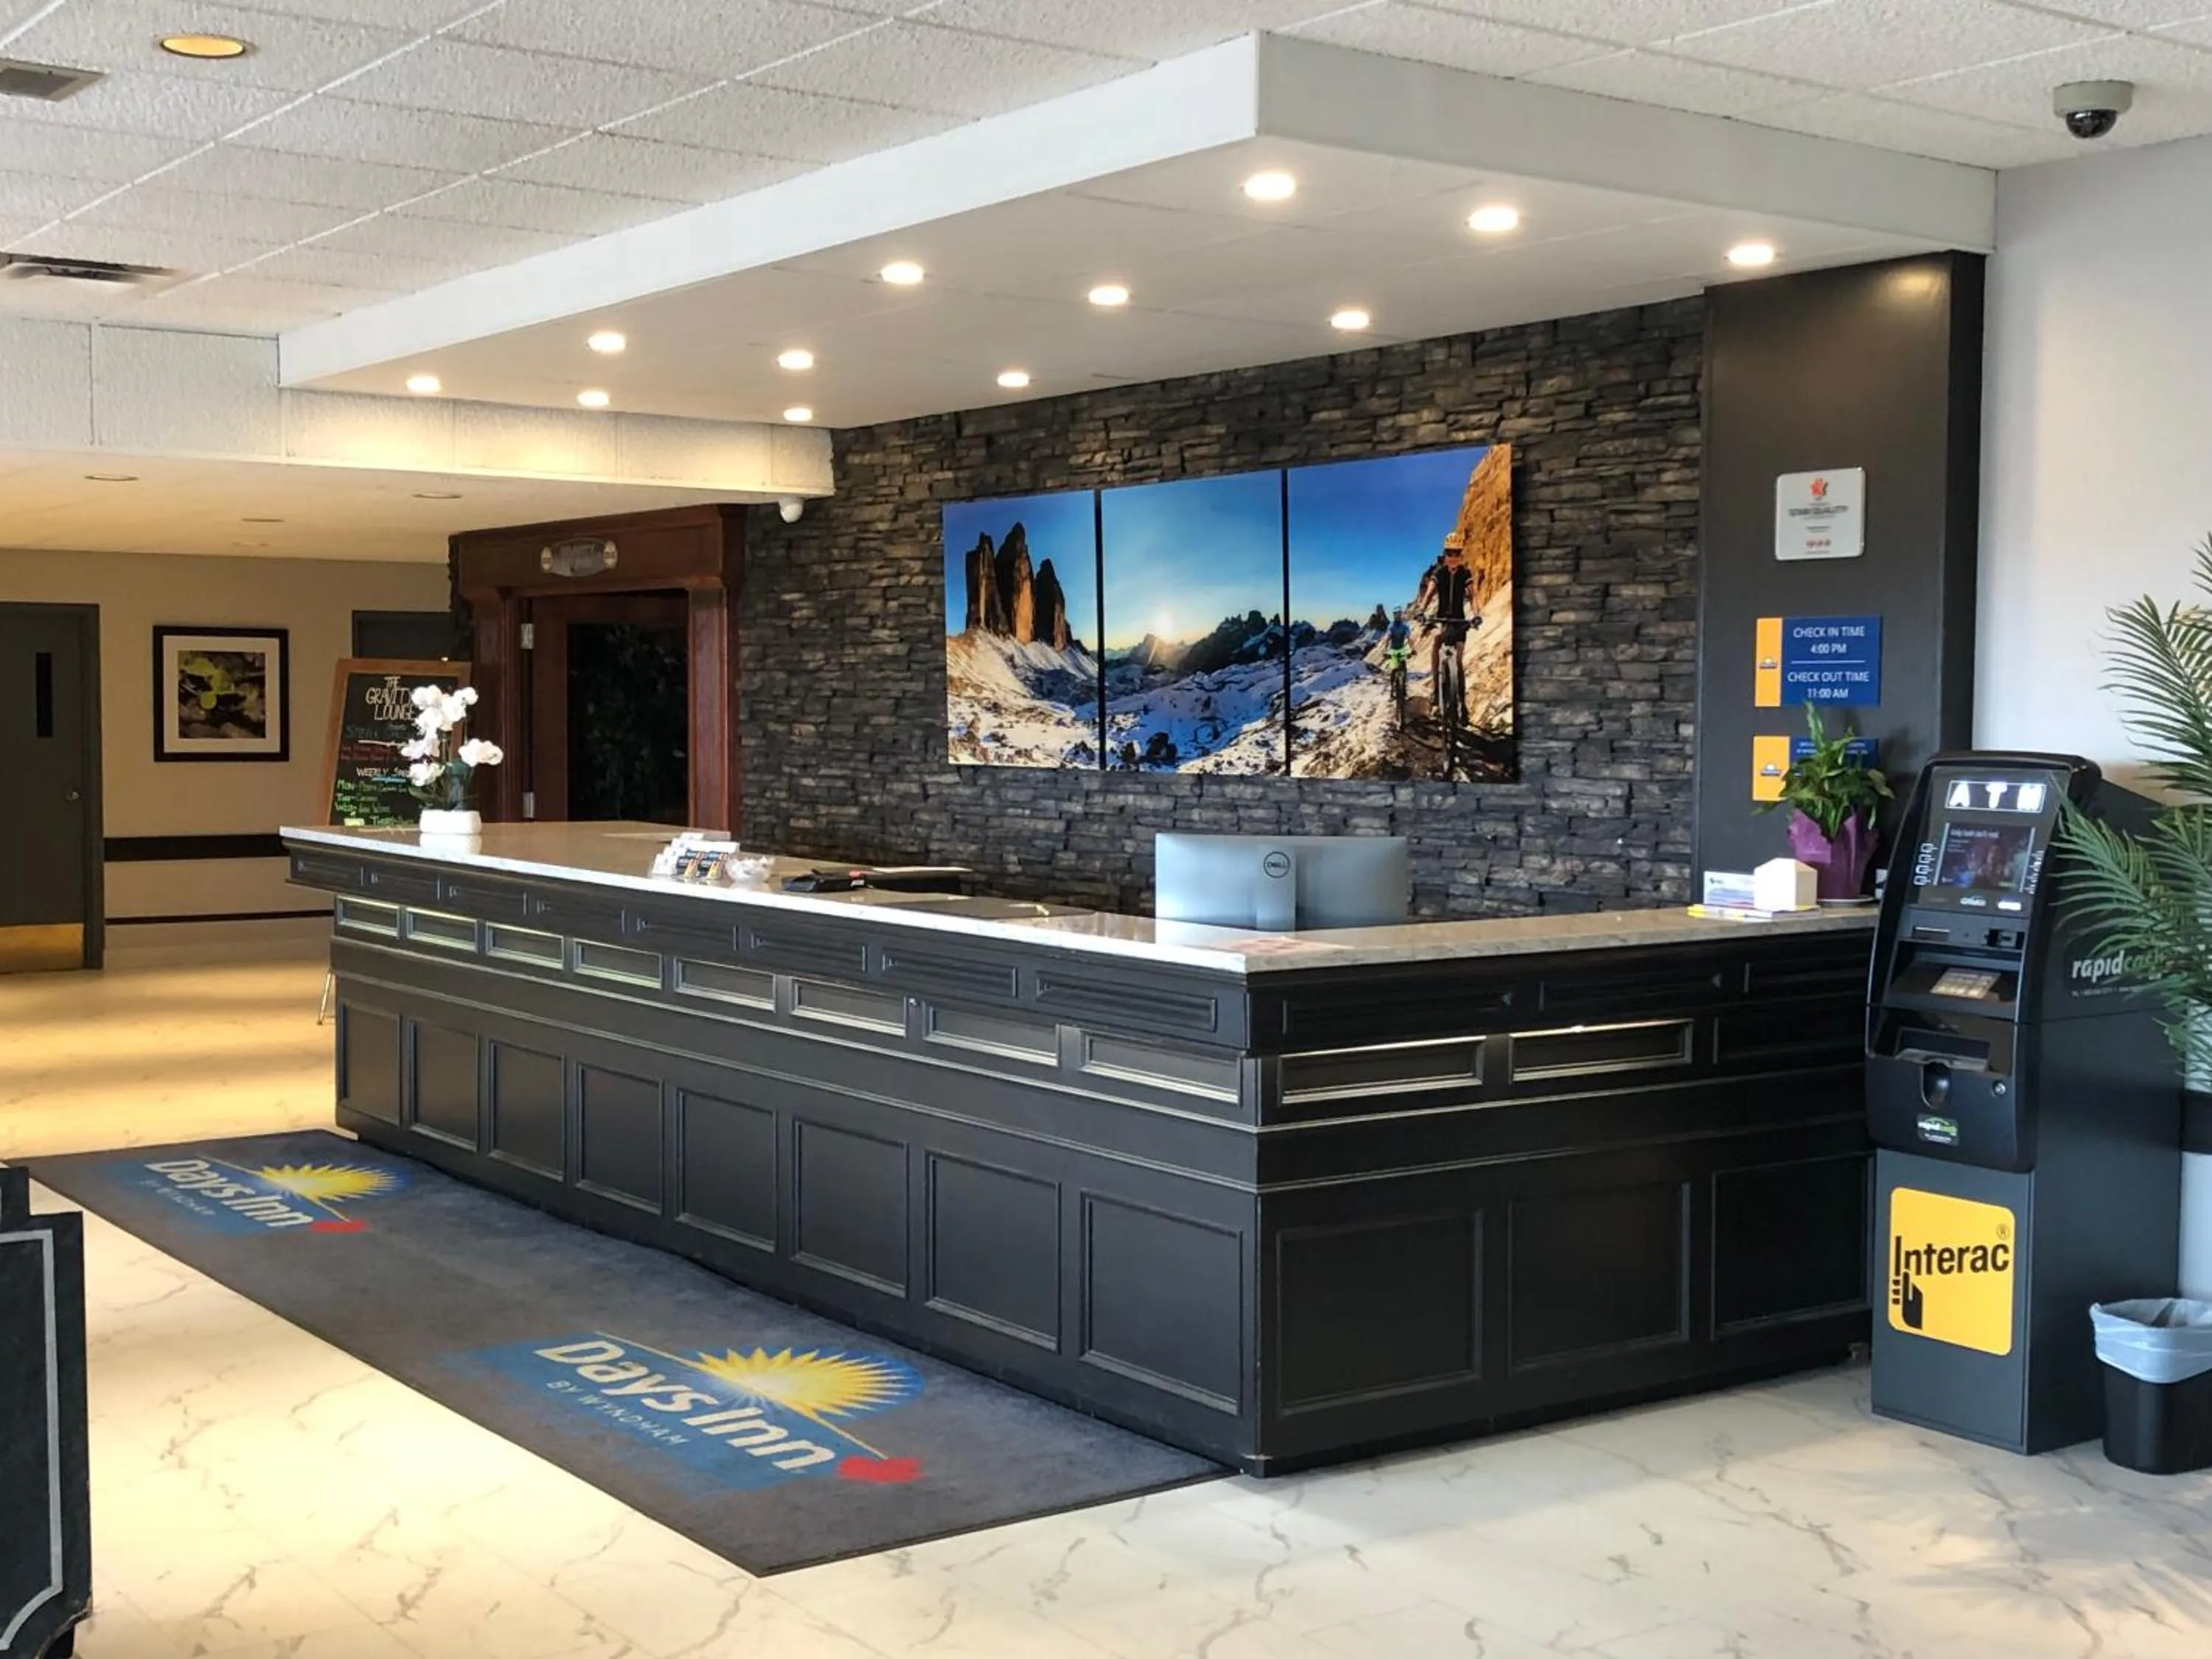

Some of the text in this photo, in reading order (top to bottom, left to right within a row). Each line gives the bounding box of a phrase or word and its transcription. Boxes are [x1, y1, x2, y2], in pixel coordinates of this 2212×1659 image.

[1792, 626, 1865, 638] CHECK IN TIME
[1810, 643, 1847, 654] 4:00 PM
[1787, 672, 1870, 683] CHECK OUT TIME
[1807, 688, 1848, 698] 11:00 AM
[374, 703, 415, 720] LOUNGE
[1949, 782, 2043, 812] ATM
[1894, 1235, 2011, 1277] Interac
[546, 1380, 584, 1396] BY
[532, 1340, 836, 1471] Days Inn
